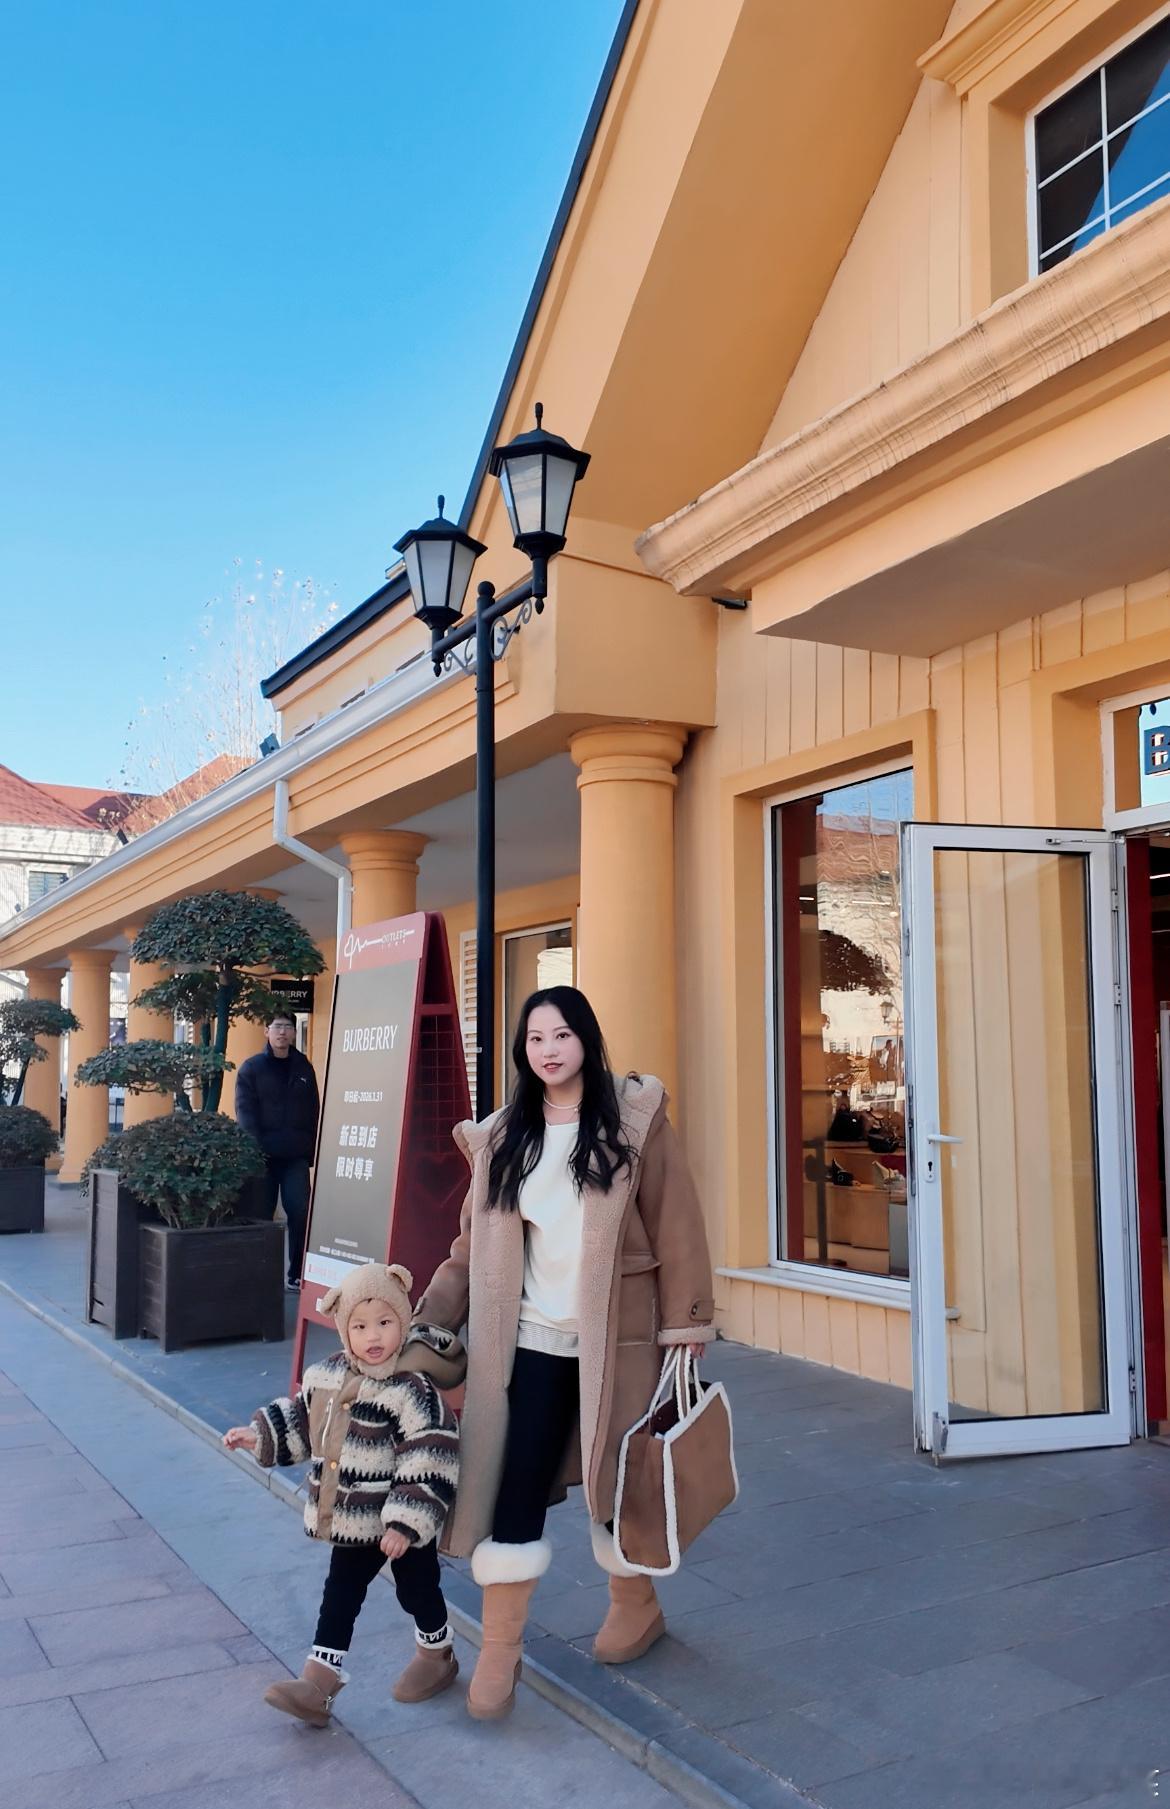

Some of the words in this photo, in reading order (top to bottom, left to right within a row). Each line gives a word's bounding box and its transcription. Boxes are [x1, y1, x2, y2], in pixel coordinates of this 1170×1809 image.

[343, 1025, 398, 1052] BURBERRY
[339, 1125, 378, 1147] 新品到店
[335, 1156, 374, 1180] 限时尊享
